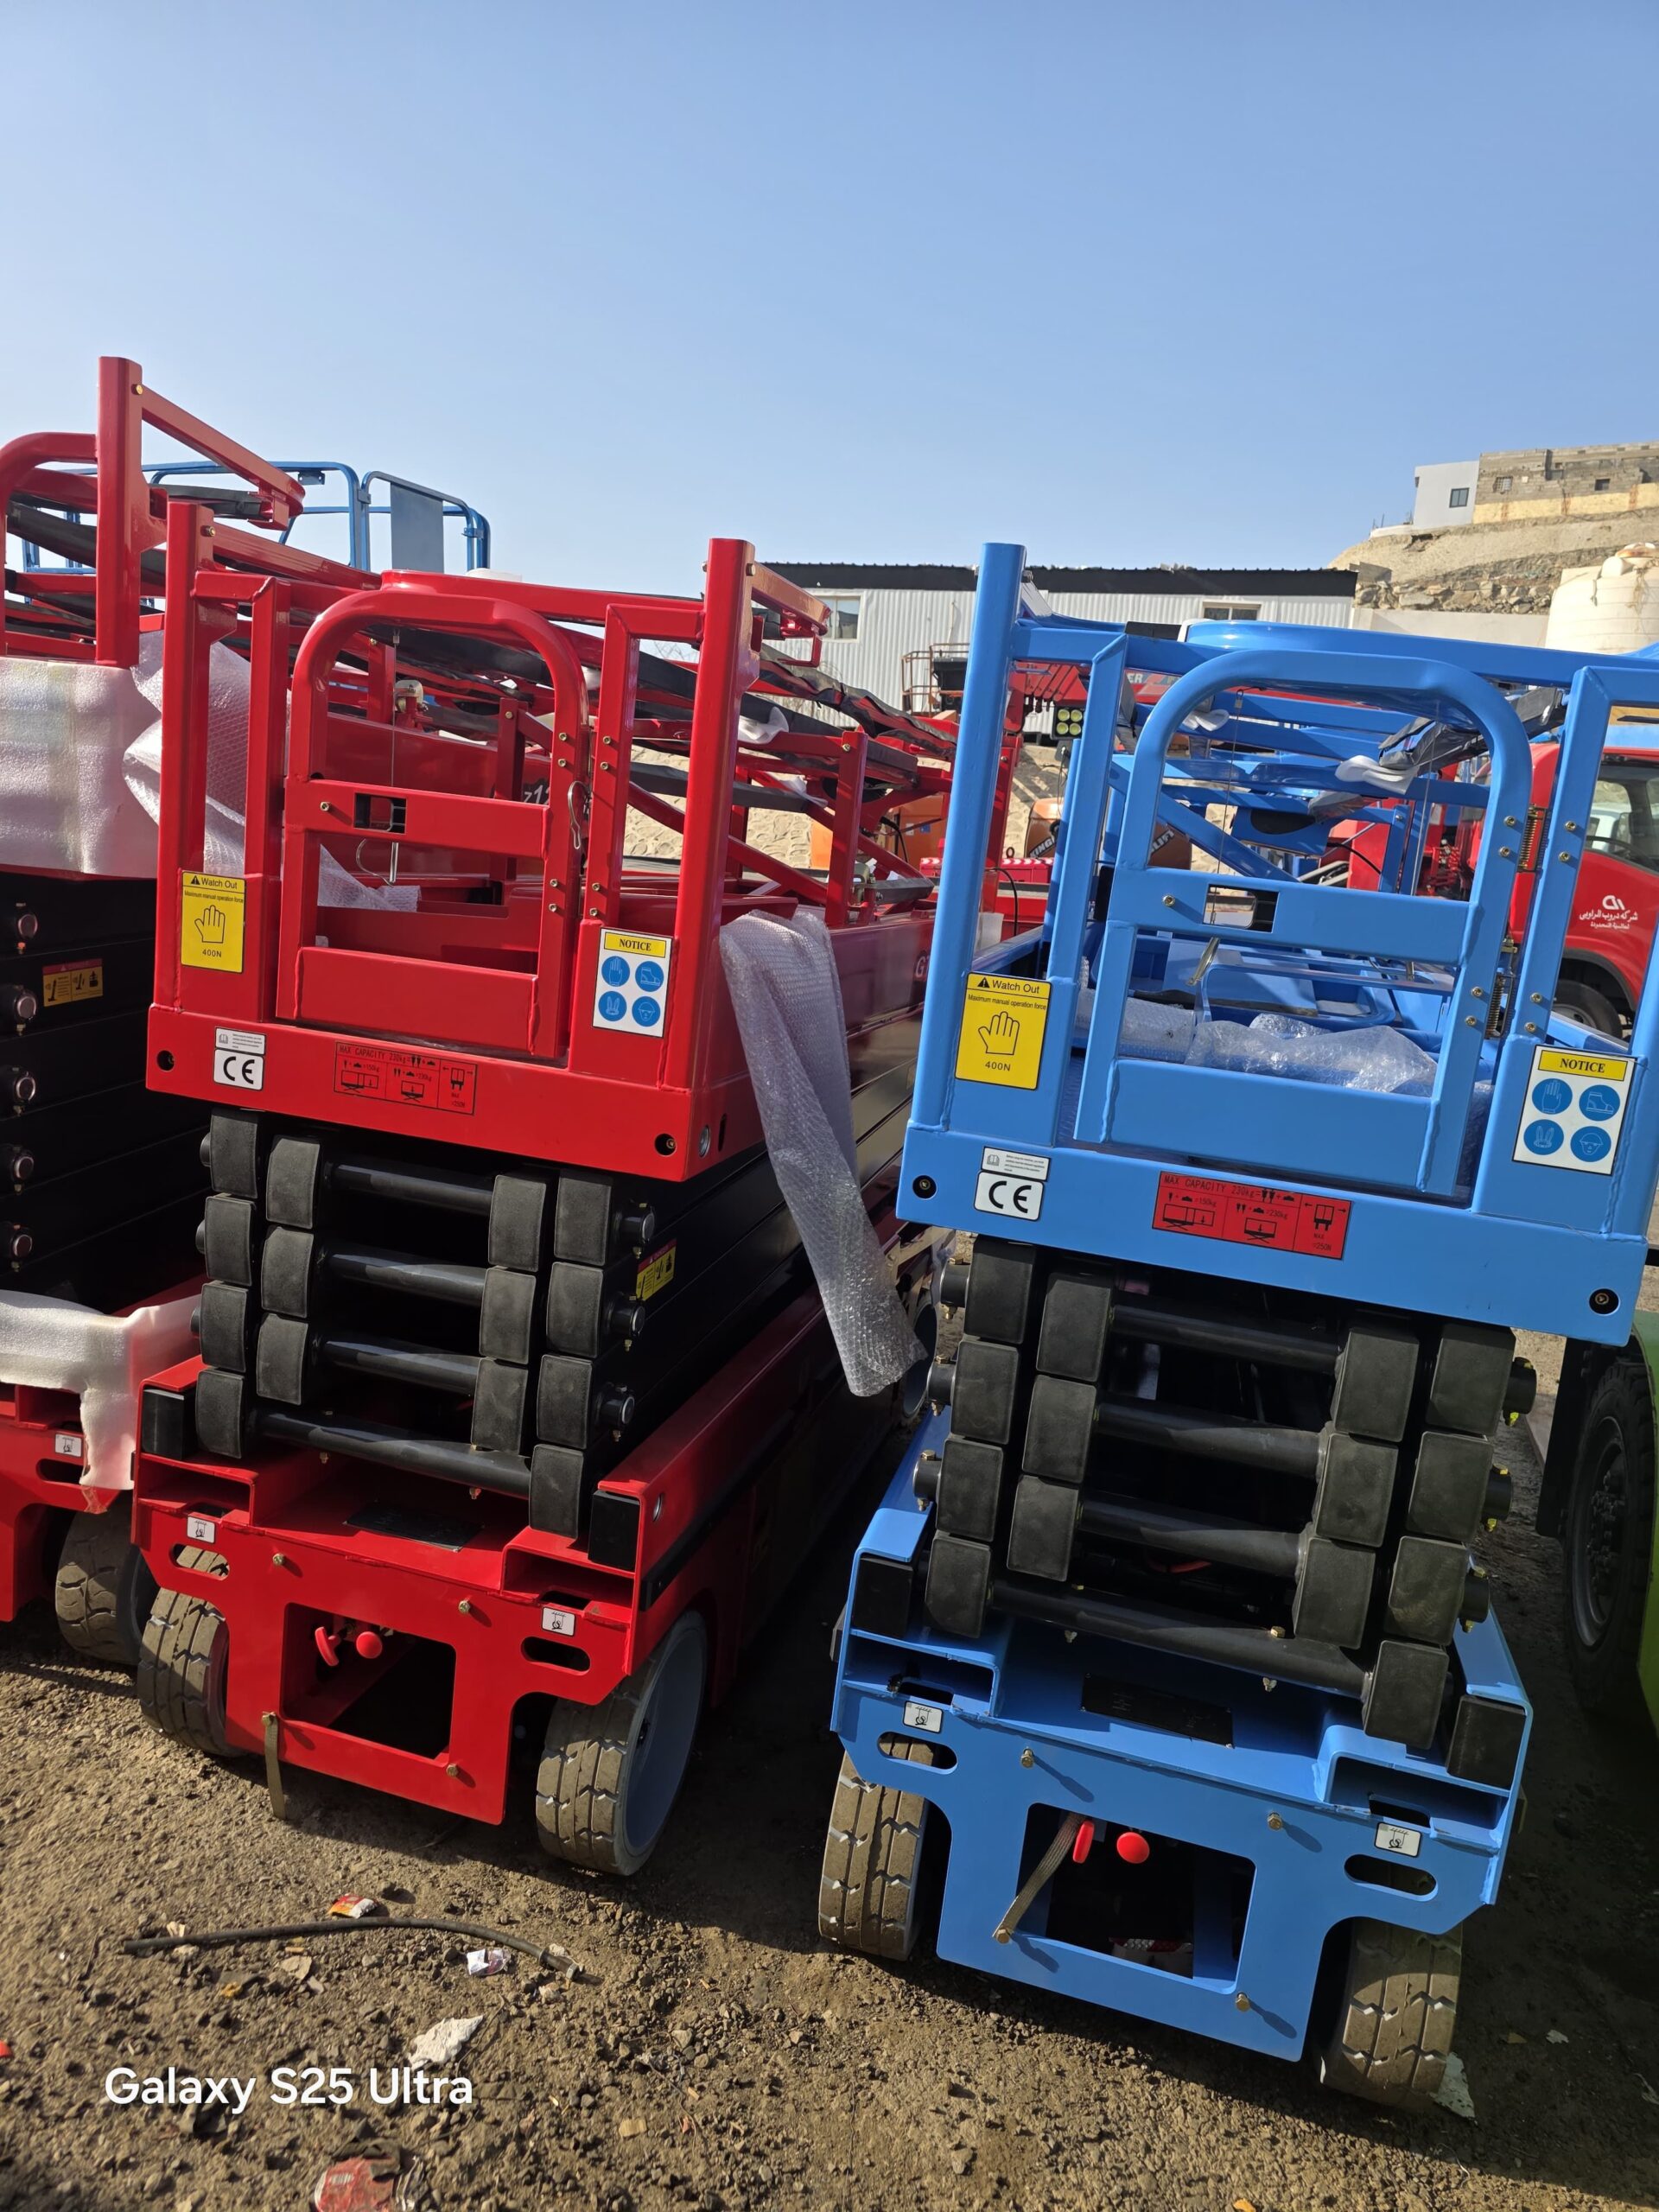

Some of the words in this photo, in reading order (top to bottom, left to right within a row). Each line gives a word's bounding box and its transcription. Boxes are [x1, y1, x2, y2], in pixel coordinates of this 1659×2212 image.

[201, 877, 222, 887] Watch
[225, 880, 238, 889] Out
[619, 938, 652, 951] NOTICE
[202, 949, 222, 957] 400N
[992, 979, 1020, 991] Watch
[1023, 983, 1039, 994] Out
[968, 994, 991, 1003] Maximum
[1010, 1000, 1033, 1008] operation
[340, 1044, 352, 1053] MAX
[354, 1047, 385, 1060] CAPACITY
[223, 1056, 255, 1084] CE
[985, 1061, 1011, 1071] 400N
[1560, 1058, 1606, 1073] NOTICE
[1164, 1174, 1179, 1185] MAX
[1185, 1178, 1227, 1192] CAPACITY
[988, 1180, 1032, 1213] CE
